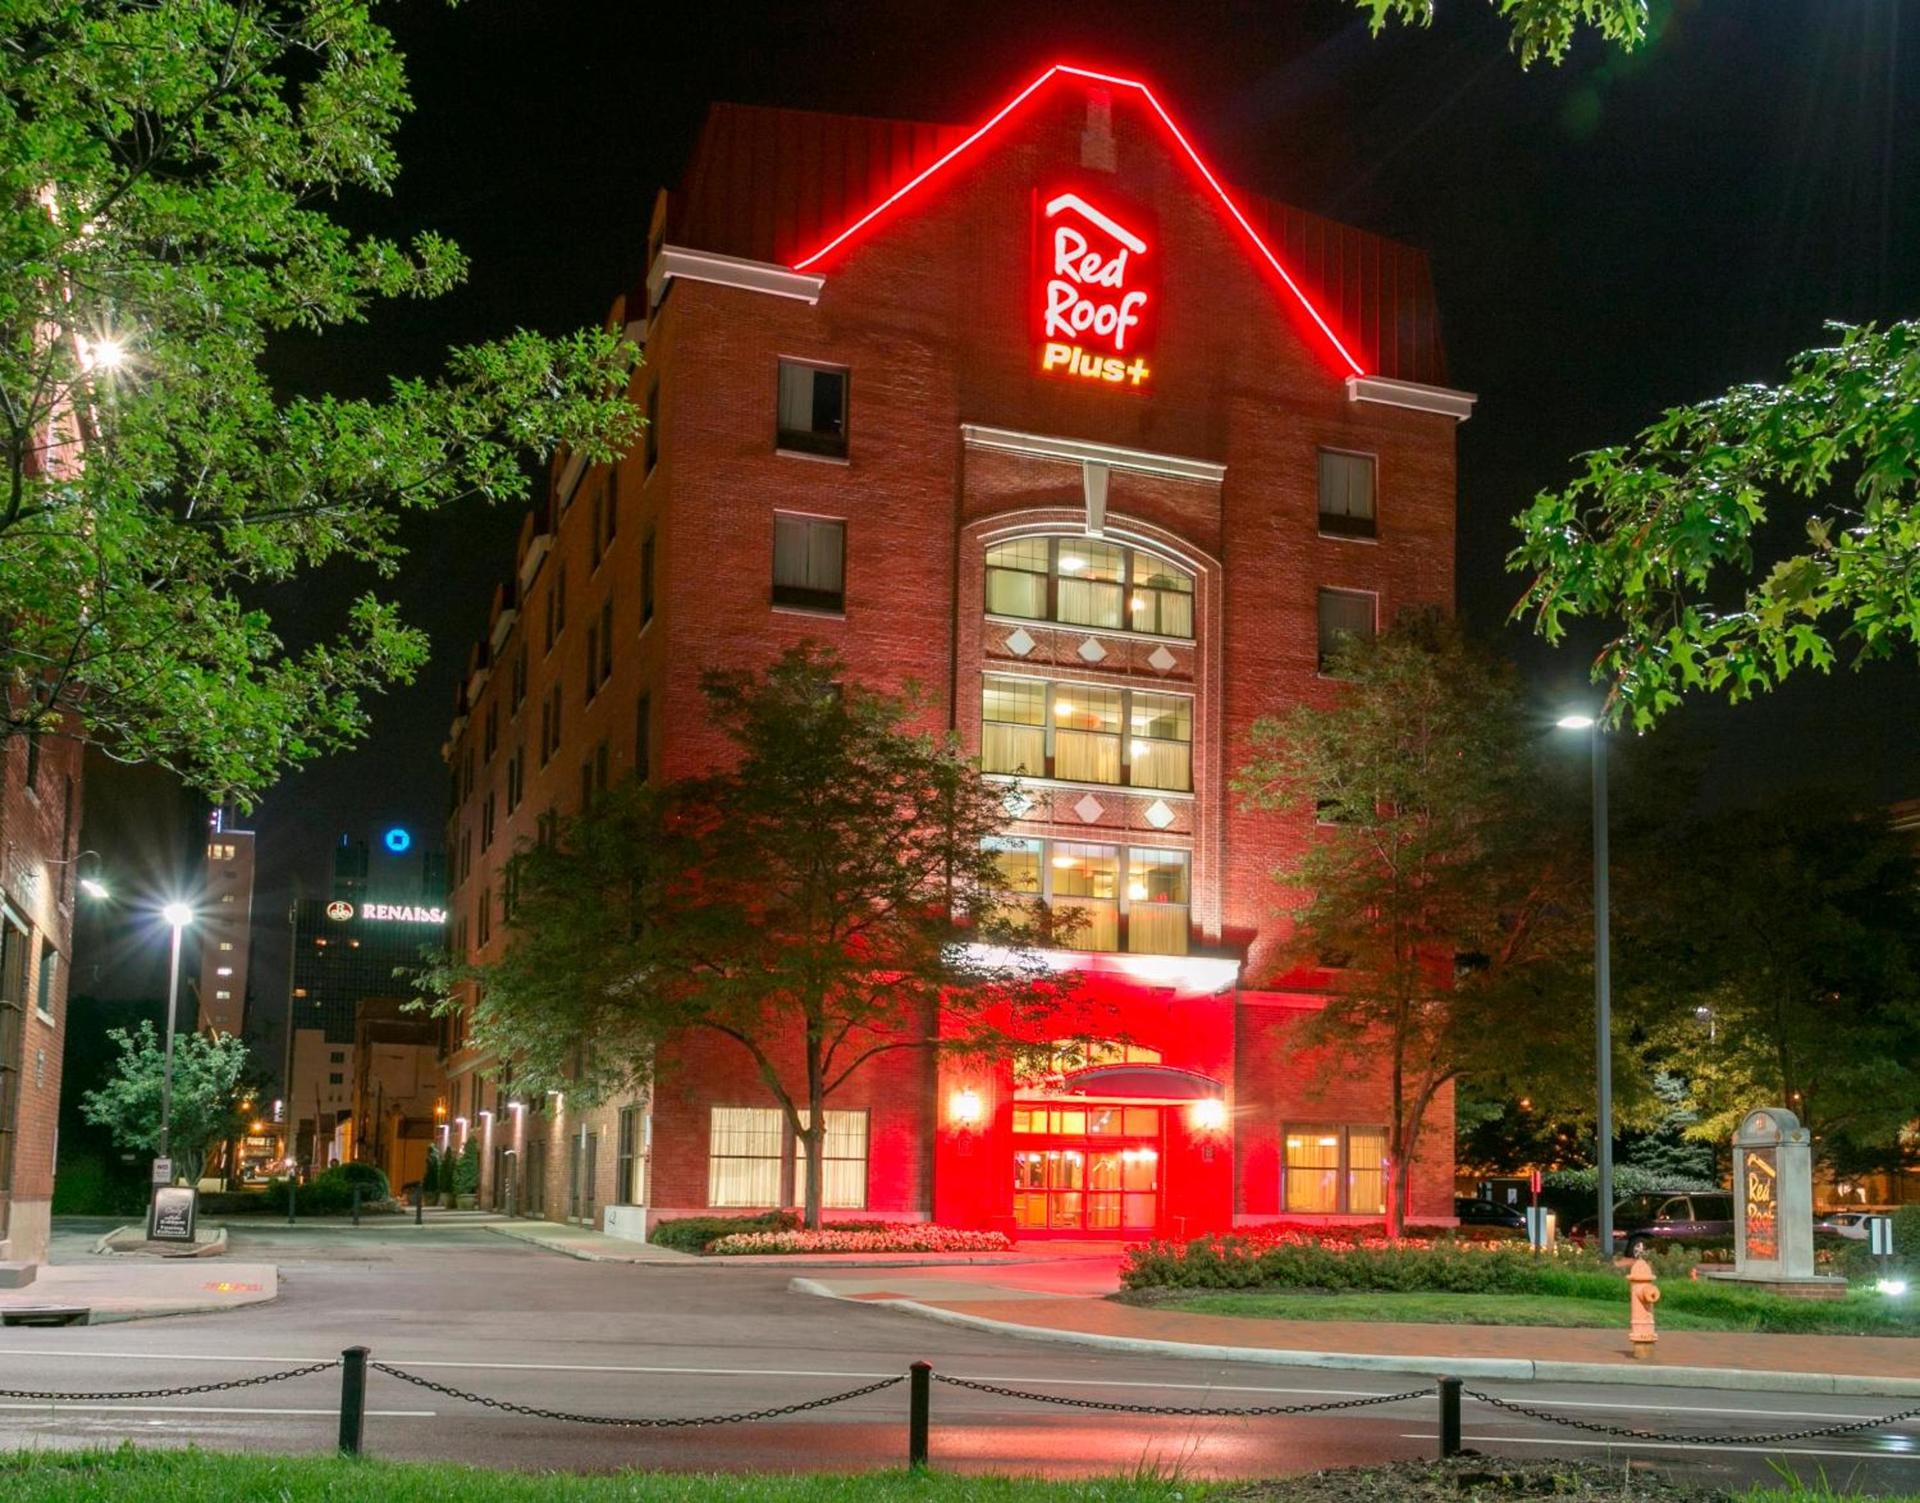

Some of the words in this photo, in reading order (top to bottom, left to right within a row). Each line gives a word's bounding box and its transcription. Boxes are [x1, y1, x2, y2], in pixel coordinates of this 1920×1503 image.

[1055, 226, 1128, 288] Red
[1045, 279, 1147, 350] Roof
[1043, 342, 1150, 385] Plus+
[1748, 1172, 1771, 1202] Red
